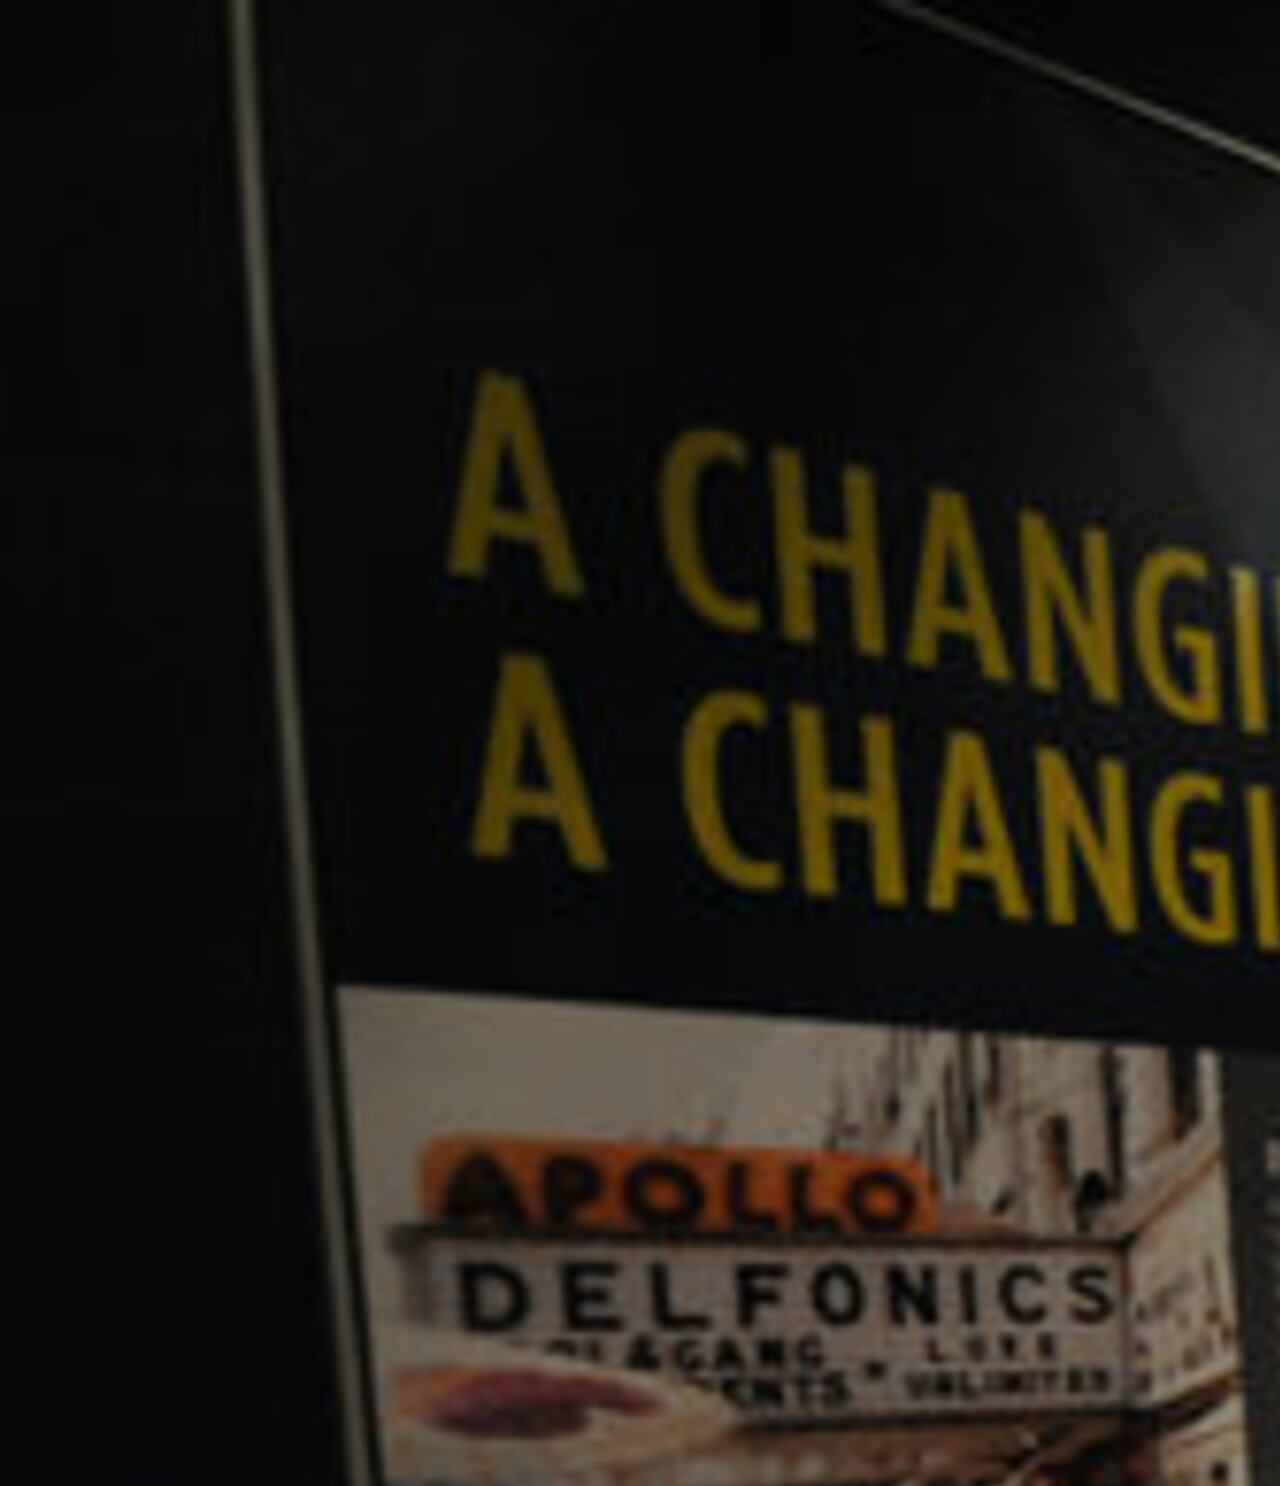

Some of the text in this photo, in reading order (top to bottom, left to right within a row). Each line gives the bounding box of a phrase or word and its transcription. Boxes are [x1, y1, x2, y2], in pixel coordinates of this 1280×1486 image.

[447, 370, 583, 596] A
[472, 652, 608, 870] A
[441, 1149, 918, 1234] APOLLO
[457, 1260, 1118, 1333] DELFONICS
